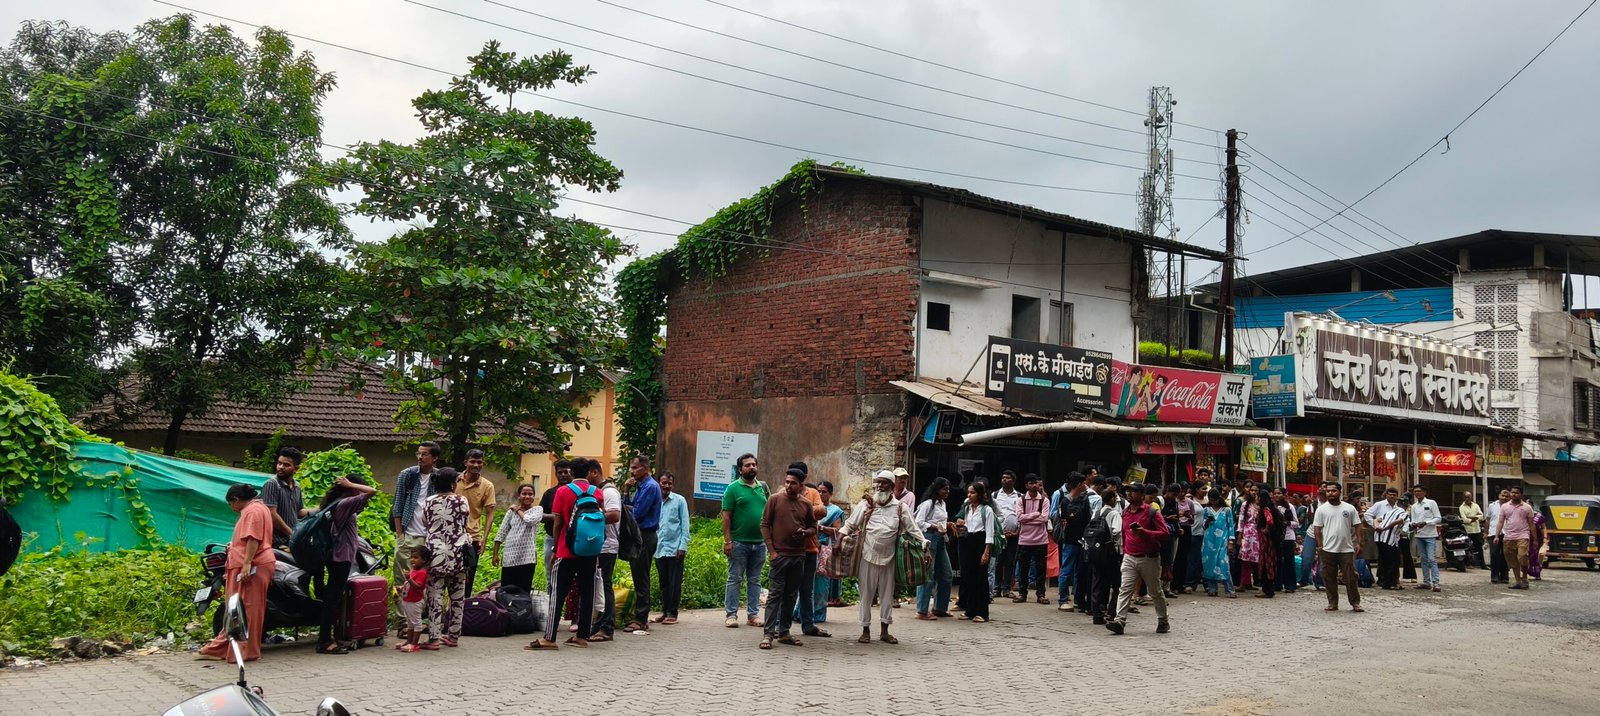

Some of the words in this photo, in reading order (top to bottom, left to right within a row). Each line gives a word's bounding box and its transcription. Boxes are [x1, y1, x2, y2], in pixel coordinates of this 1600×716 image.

[1014, 350, 1050, 376] एस.के
[1323, 350, 1373, 397] जय
[1374, 345, 1419, 404] अंबे
[1160, 378, 1218, 410] Coca-Cola
[1226, 377, 1246, 399] साई
[1076, 397, 1104, 406] Accessories
[1217, 397, 1245, 417] बेकरी
[1434, 453, 1472, 466] Coca-Cola
